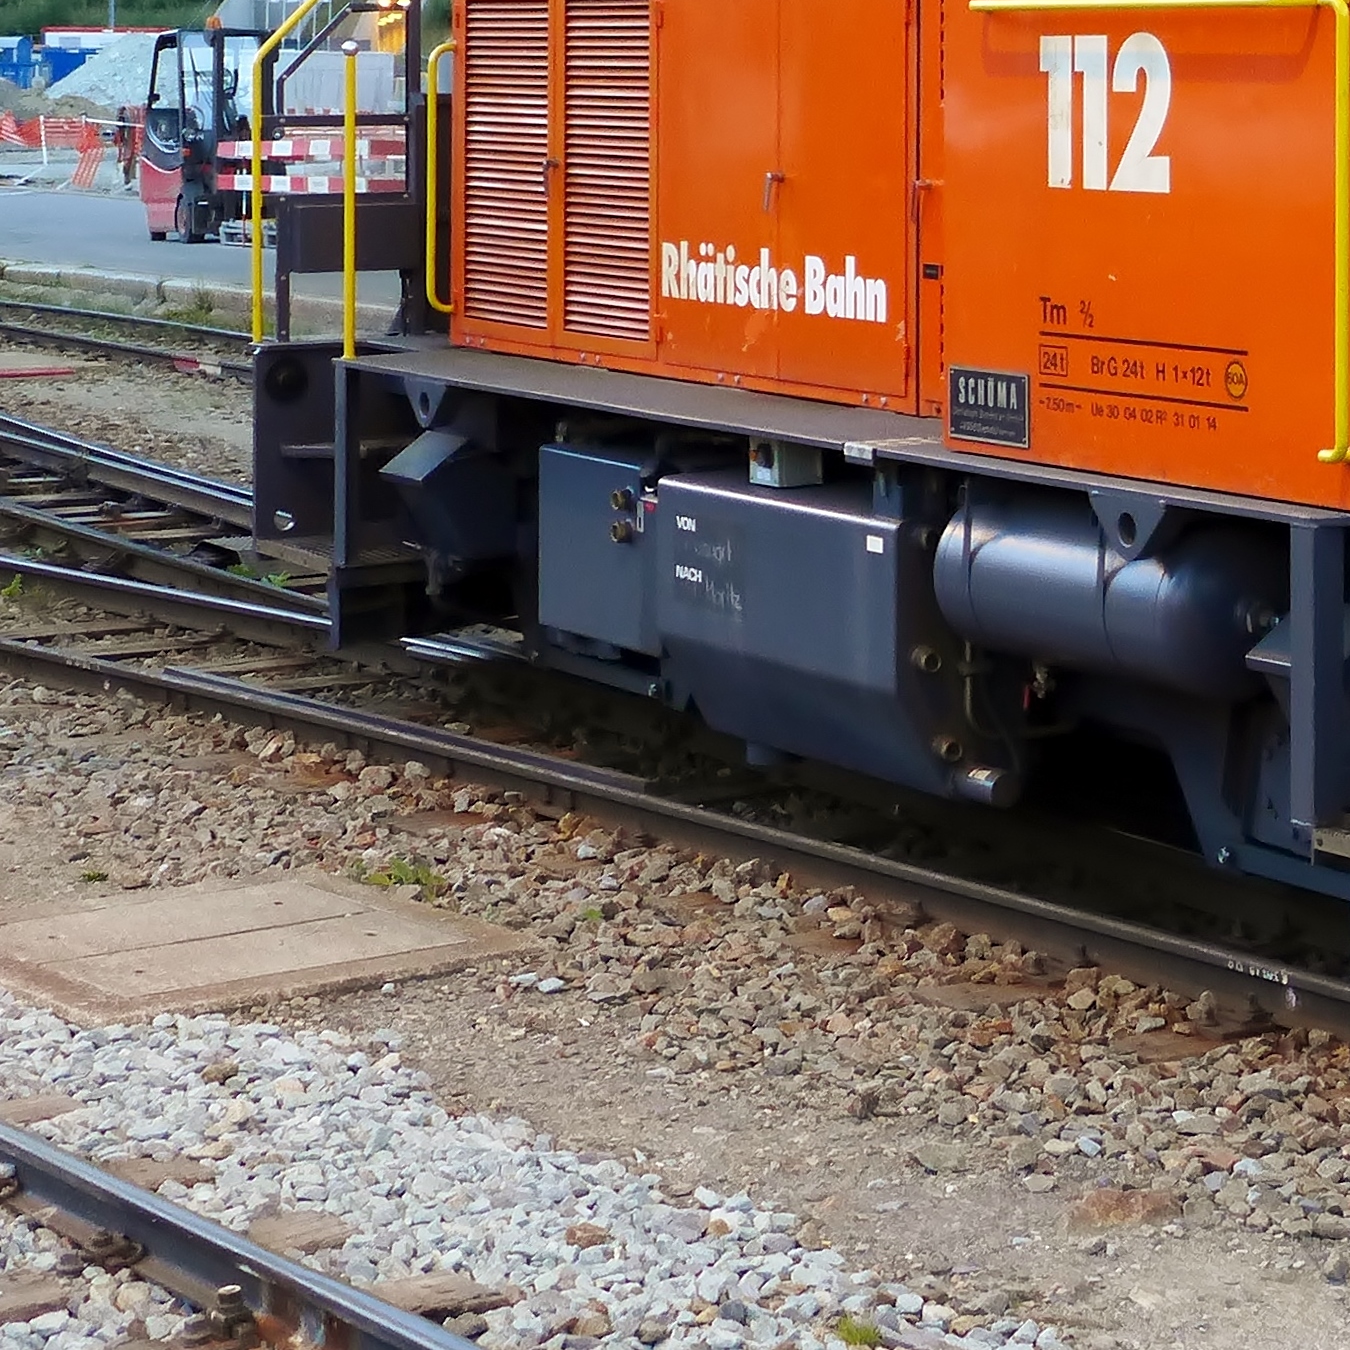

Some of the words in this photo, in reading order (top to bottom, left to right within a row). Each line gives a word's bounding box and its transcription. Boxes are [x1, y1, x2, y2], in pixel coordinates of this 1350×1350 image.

[1039, 31, 1172, 193] 112
[661, 240, 797, 313] Rhätische
[804, 255, 886, 323] Bahn
[1039, 296, 1067, 325] Tm
[1155, 363, 1166, 381] H
[958, 376, 1017, 410] SCHÜMA
[1172, 412, 1184, 427] 31
[1188, 414, 1200, 429] 01
[676, 515, 696, 532] VON
[675, 564, 702, 582] NACH
